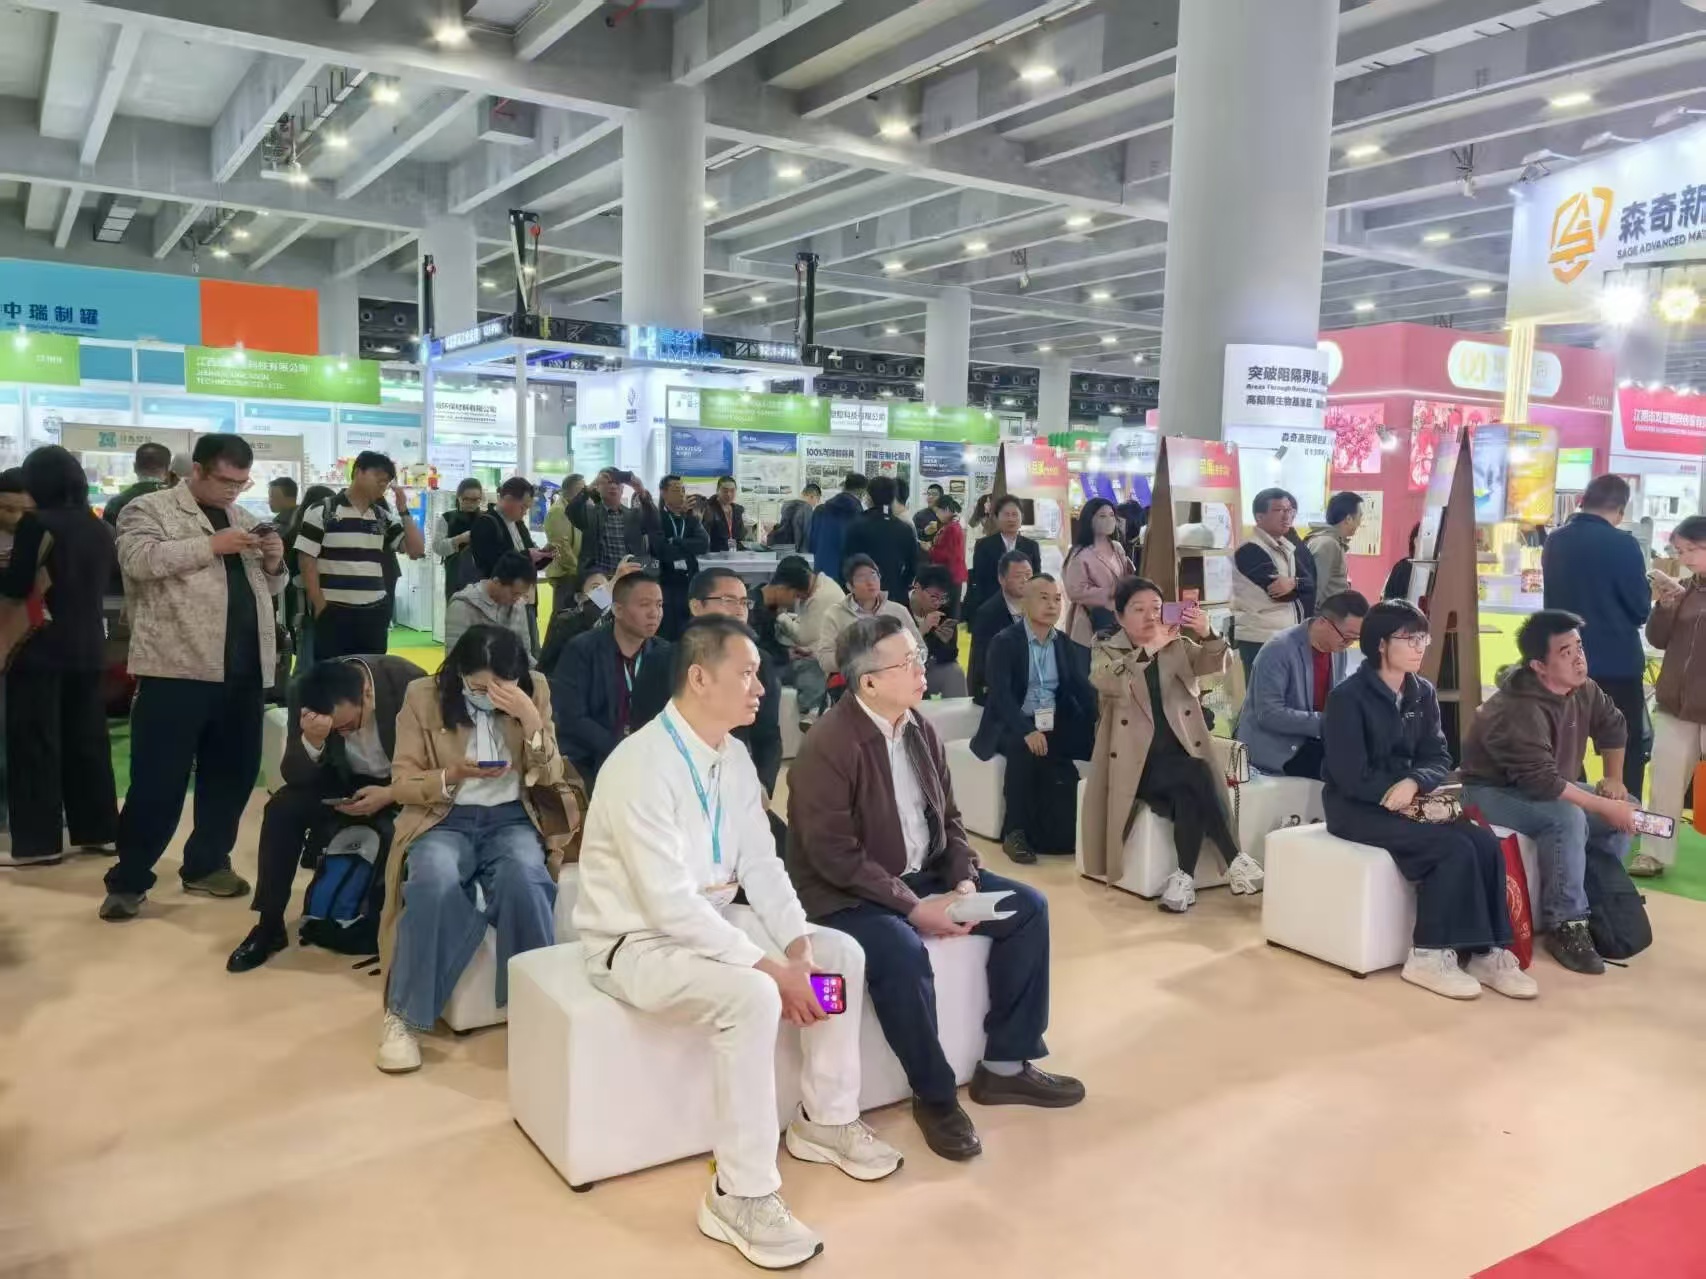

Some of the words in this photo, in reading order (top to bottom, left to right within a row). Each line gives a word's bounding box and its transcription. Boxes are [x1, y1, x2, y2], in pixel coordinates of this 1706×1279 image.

[1617, 245, 1639, 259] SAGE
[1640, 233, 1686, 256] ADVANCED
[3, 301, 98, 324] 中瑞制罐
